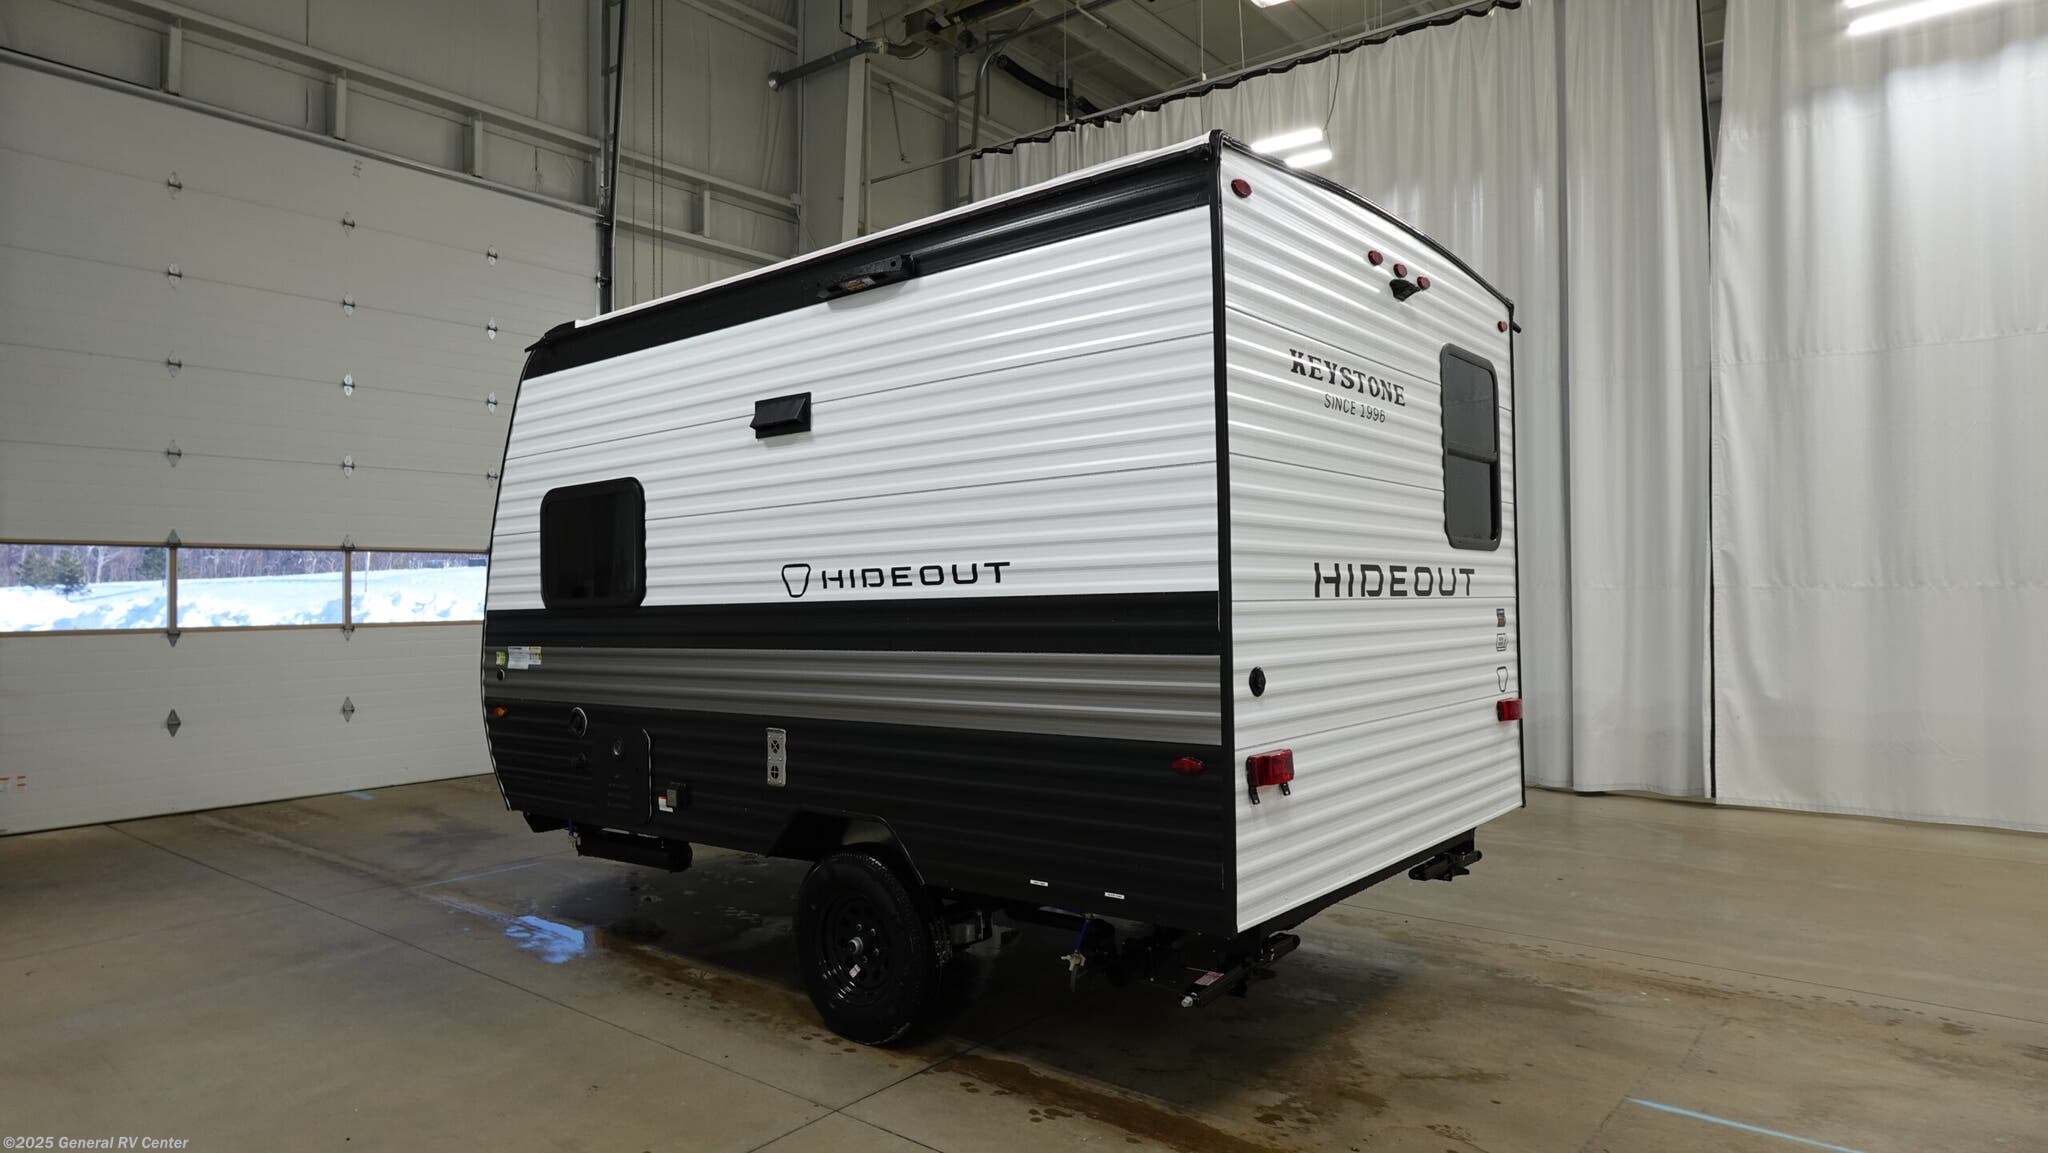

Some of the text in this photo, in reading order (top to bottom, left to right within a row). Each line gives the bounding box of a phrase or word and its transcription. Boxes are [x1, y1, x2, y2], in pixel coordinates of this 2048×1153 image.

[1289, 348, 1406, 407] KEYSTONE
[1324, 393, 1386, 424] SINCE 1996
[821, 561, 1011, 589] HIDEOUT
[1313, 562, 1475, 598] HIDEOUT
